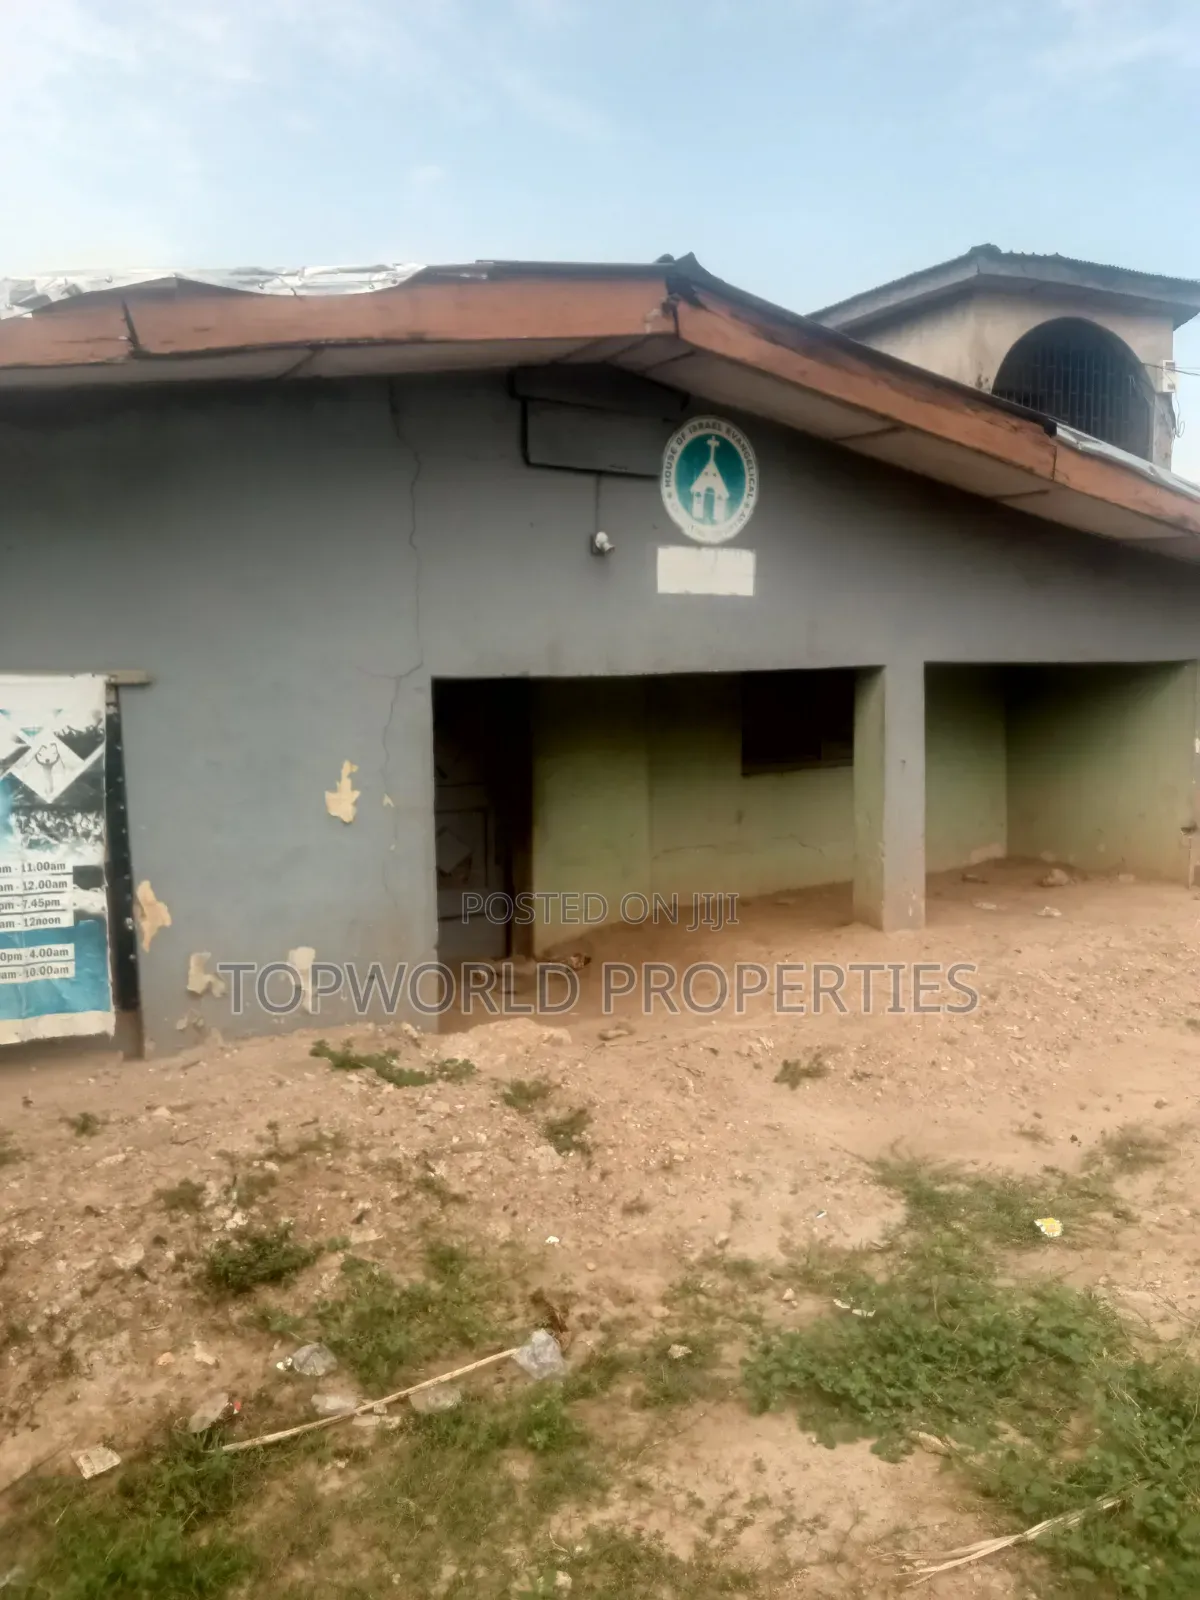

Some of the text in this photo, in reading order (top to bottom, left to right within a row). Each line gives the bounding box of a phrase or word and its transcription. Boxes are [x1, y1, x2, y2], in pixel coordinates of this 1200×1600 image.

[664, 421, 756, 499] HOUSE OF ISRAEL EVANGELICAL
[21, 861, 66, 873] 11.00am
[22, 879, 68, 891] 12.00am
[22, 898, 61, 910] 7.45pm
[24, 916, 61, 927] 12noon
[29, 947, 69, 959] 4.00am
[25, 965, 69, 978] 10.00am
